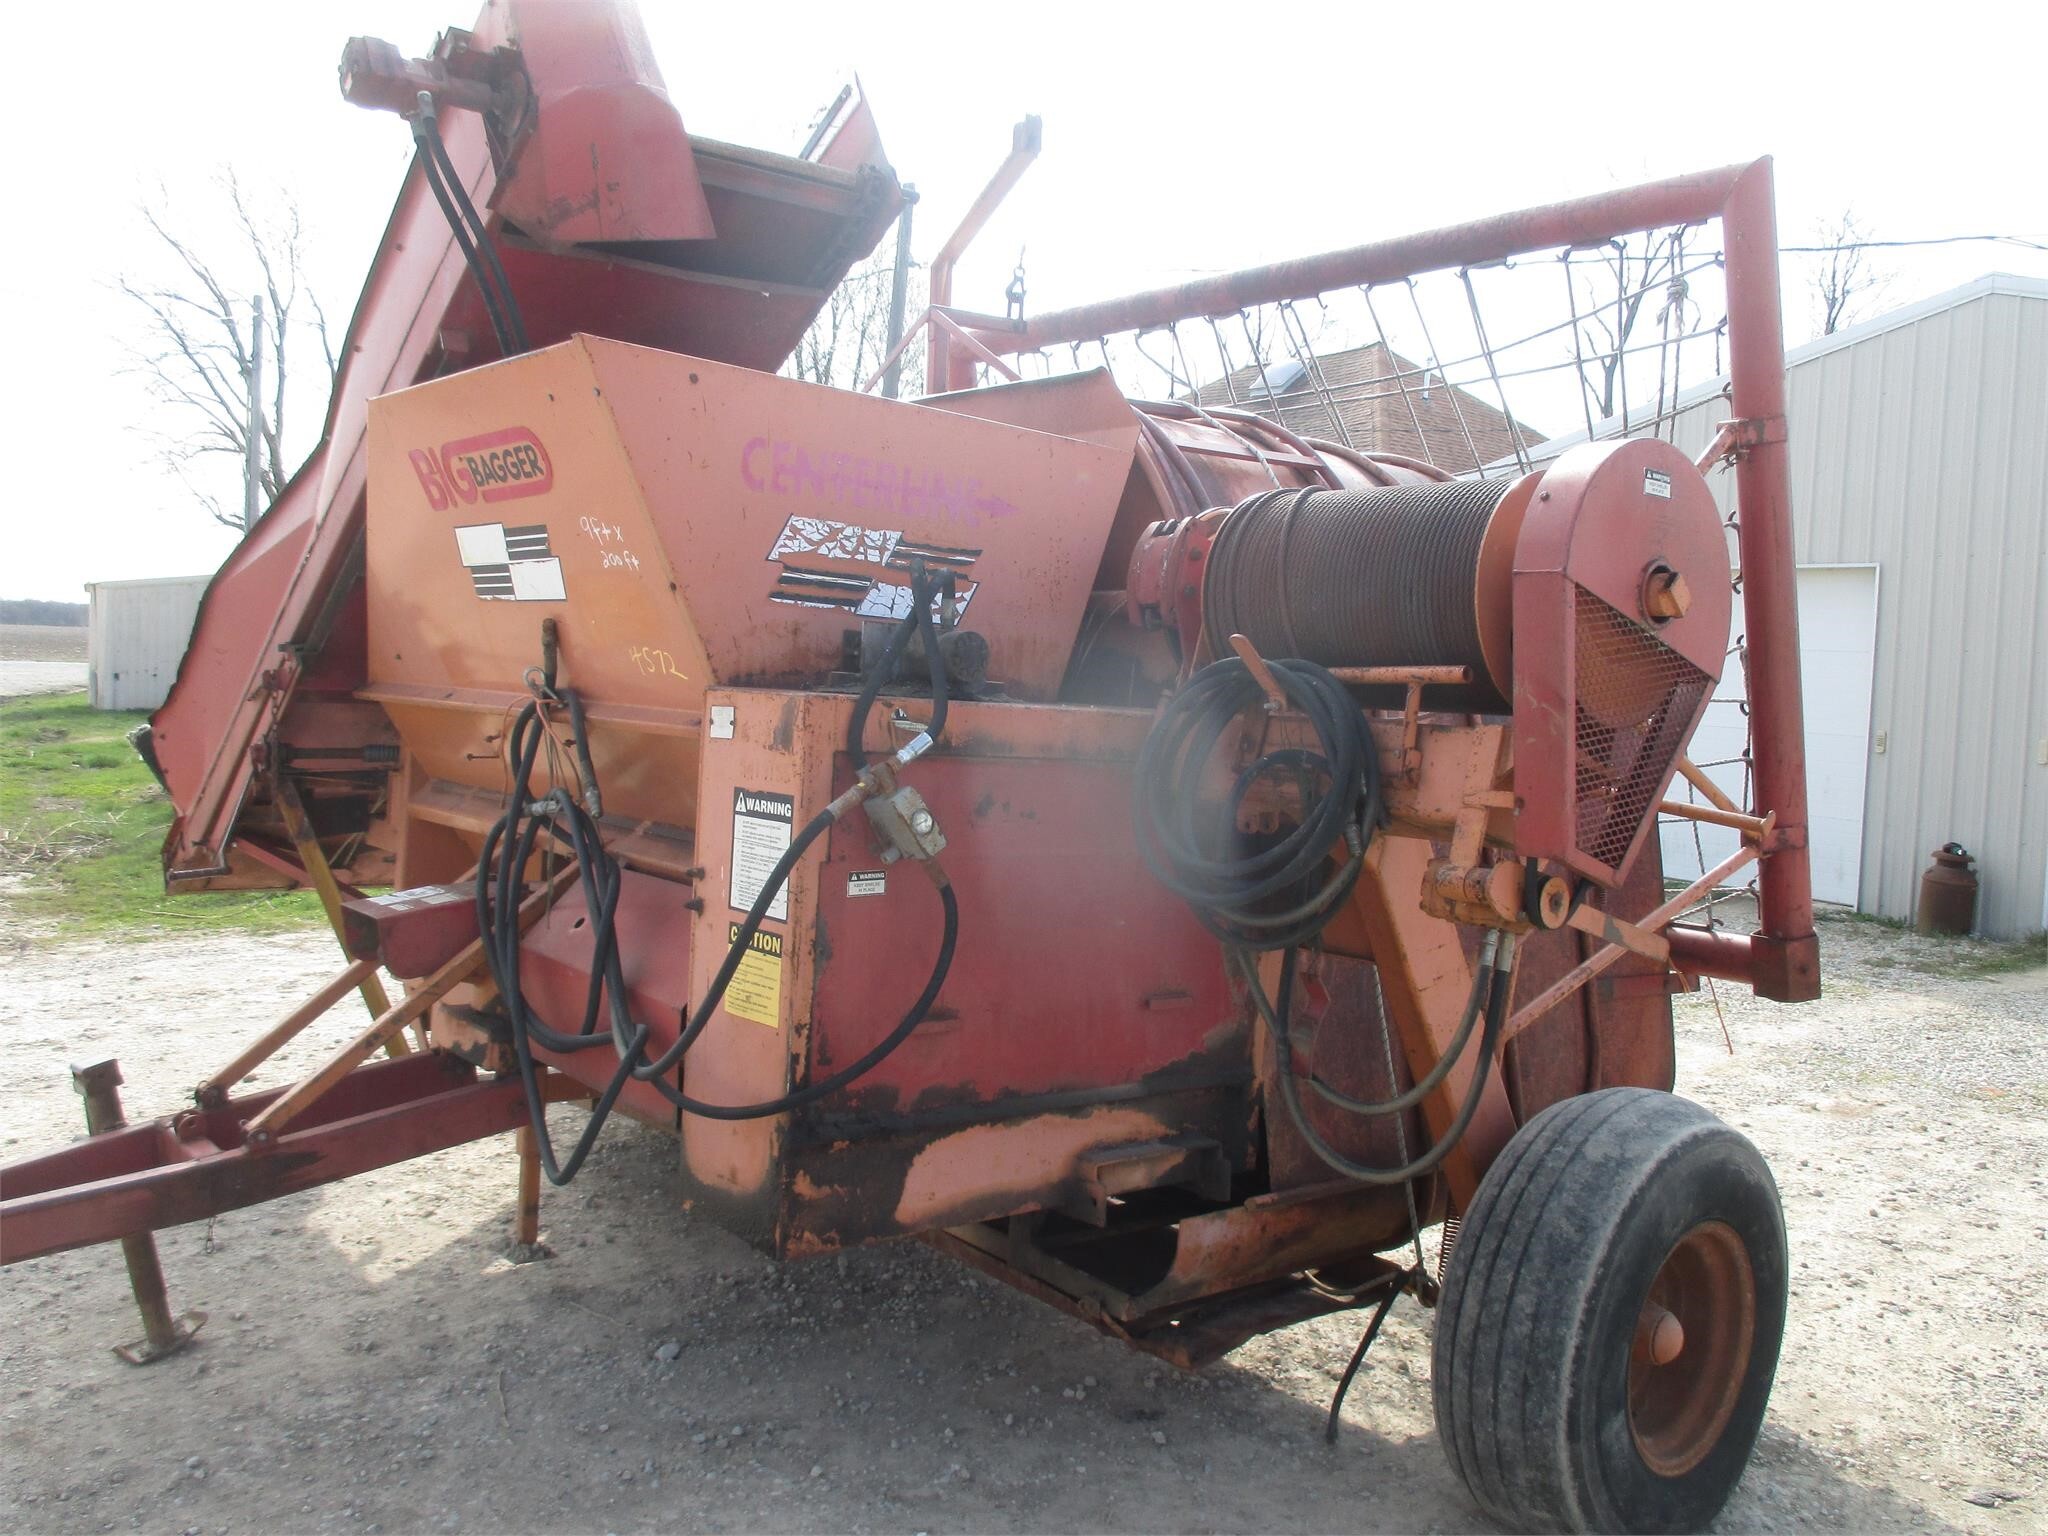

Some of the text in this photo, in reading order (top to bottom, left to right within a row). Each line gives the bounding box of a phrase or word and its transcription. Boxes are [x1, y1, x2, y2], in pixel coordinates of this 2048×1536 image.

[467, 444, 545, 487] BAGGER
[741, 437, 984, 528] CENTERLINE
[746, 797, 792, 818] WARNING
[859, 872, 885, 880] WARNING
[730, 925, 781, 954] CTION
